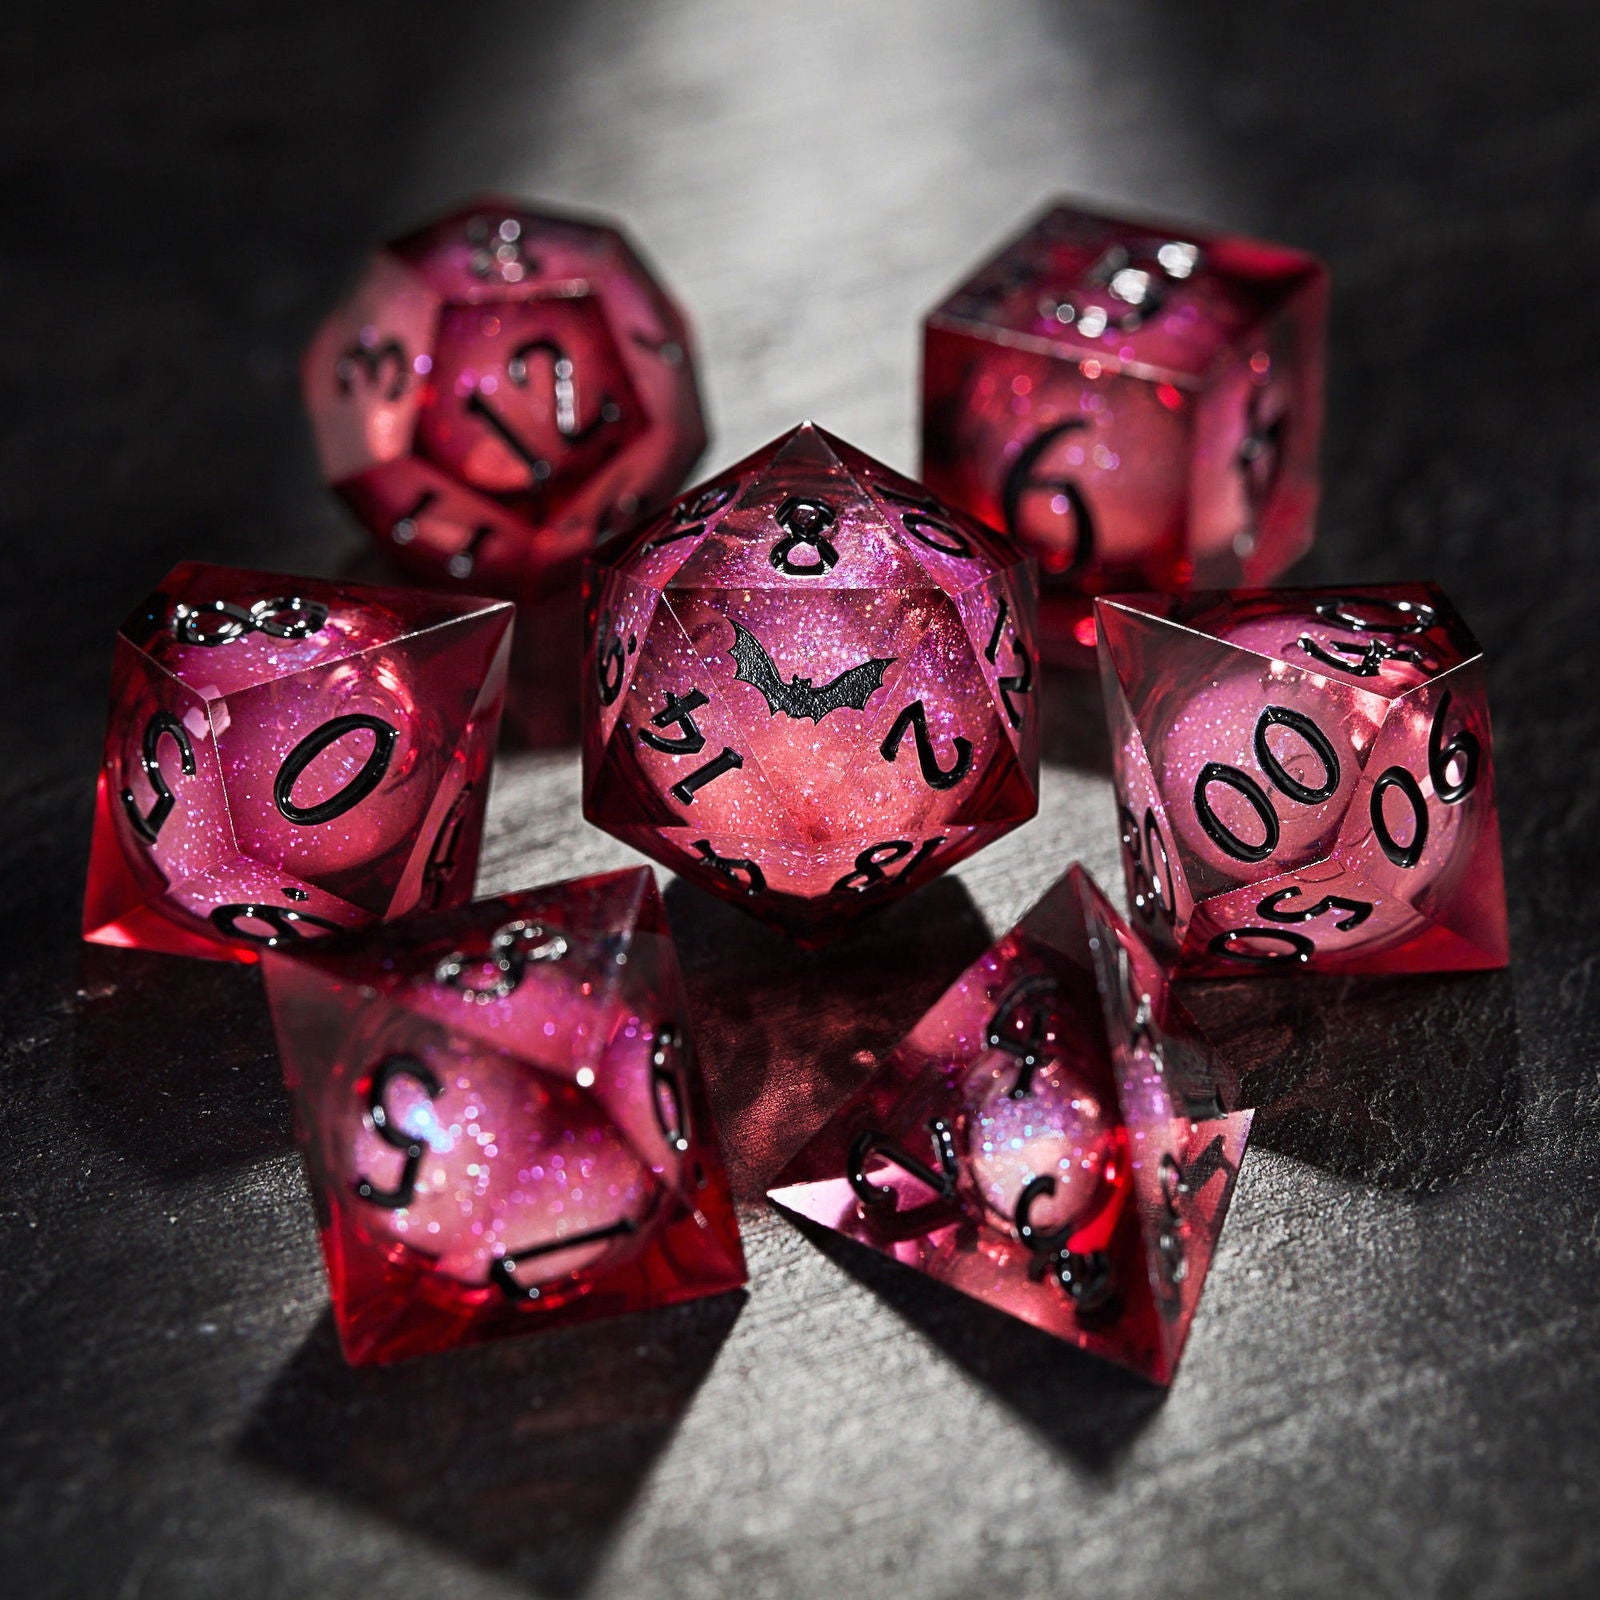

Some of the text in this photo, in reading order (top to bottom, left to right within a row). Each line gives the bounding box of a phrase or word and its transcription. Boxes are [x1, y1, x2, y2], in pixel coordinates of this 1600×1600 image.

[468, 335, 622, 478] 12
[769, 499, 839, 576] 8
[1004, 416, 1096, 578] 6
[172, 596, 329, 647] 8
[120, 710, 197, 846] 5
[273, 713, 400, 826] 0
[638, 688, 743, 806] 14
[879, 700, 973, 790] 2
[1193, 703, 1341, 864] 00
[1207, 886, 1374, 964] 50
